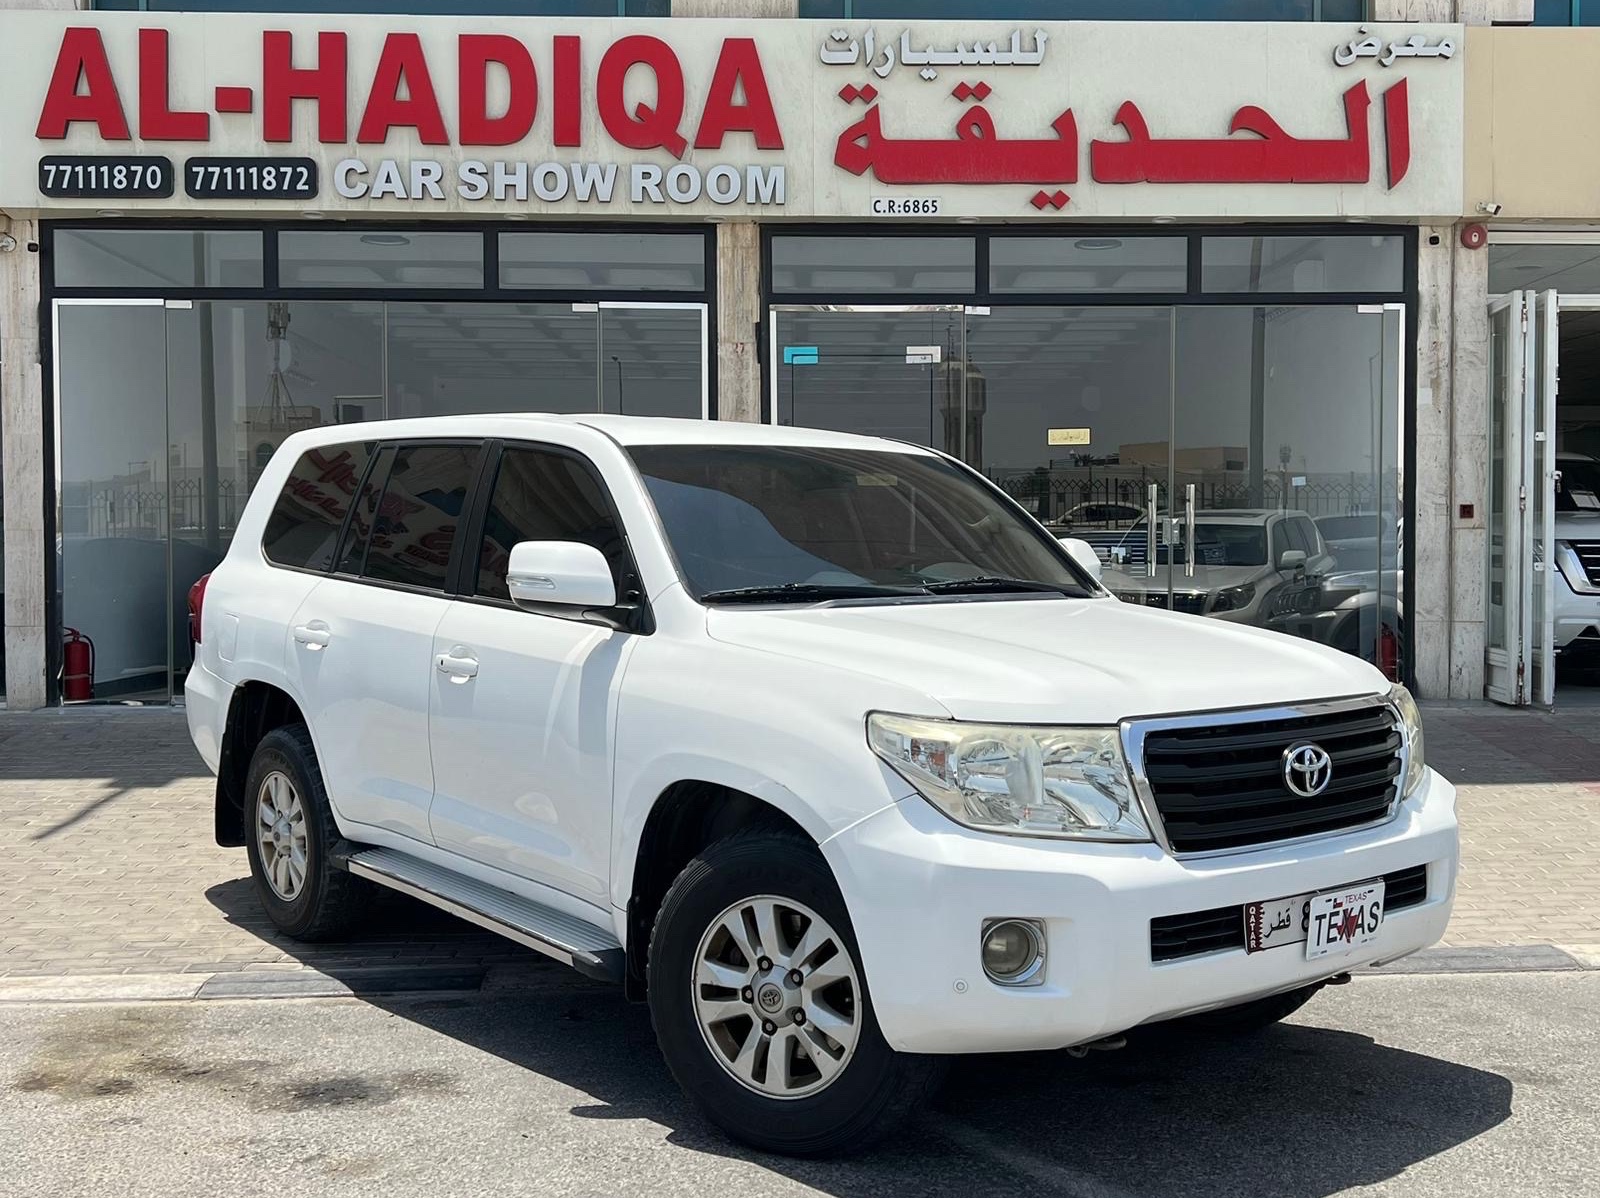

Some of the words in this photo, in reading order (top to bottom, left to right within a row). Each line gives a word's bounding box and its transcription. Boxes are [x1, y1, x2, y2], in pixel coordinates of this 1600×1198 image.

[819, 28, 1048, 81] للسيارات
[1333, 26, 1457, 68] معرض
[35, 26, 785, 160] AL-HADIQA
[834, 76, 1410, 211] الحديقة
[43, 164, 163, 191] 77111870
[191, 166, 310, 191] 77111872
[333, 158, 445, 200] CAR
[457, 161, 618, 203] SHOW
[630, 163, 787, 206] ROOM
[1345, 891, 1368, 904] TEXAS
[1249, 906, 1257, 949] QATAR
[1263, 907, 1291, 938] قطر
[1315, 901, 1380, 946] TEXAS
